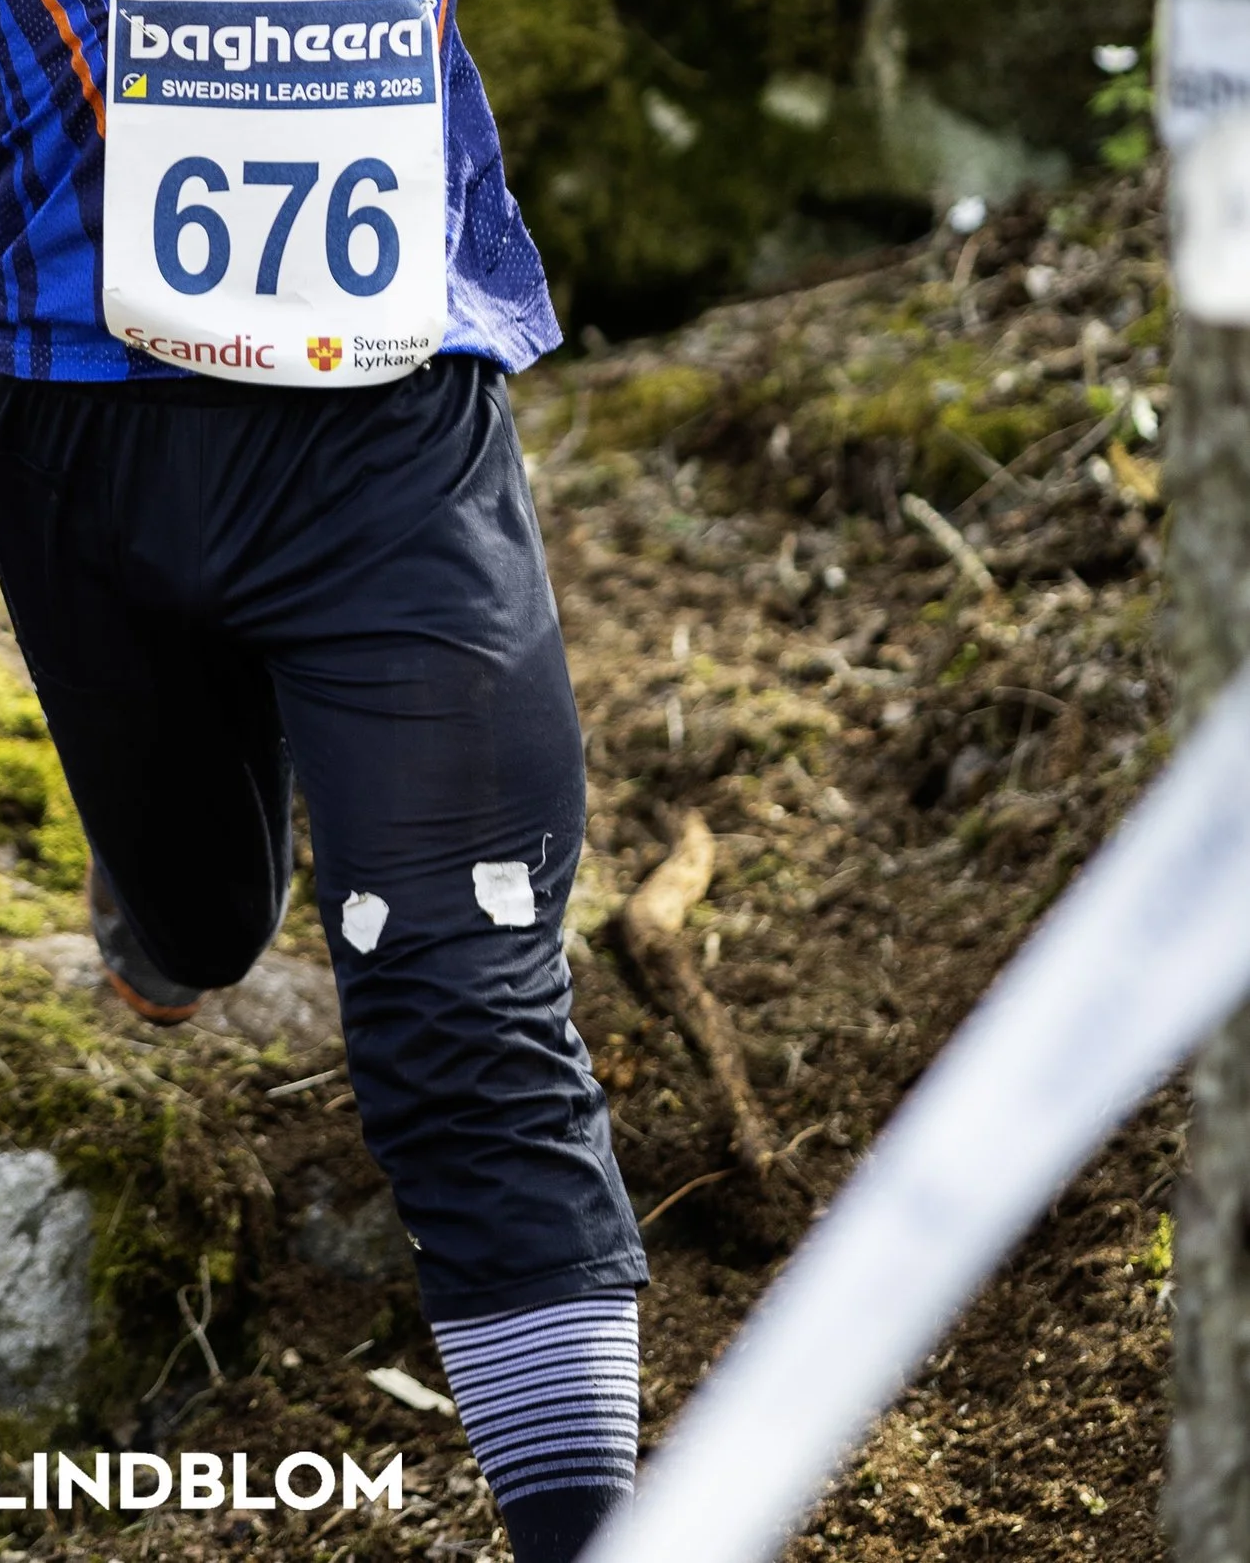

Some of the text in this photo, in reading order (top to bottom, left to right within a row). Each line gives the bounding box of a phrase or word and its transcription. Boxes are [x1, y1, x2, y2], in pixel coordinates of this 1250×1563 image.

[130, 16, 423, 71] bagheera
[161, 78, 423, 102] SWEDISH LEAGUE #3 2025
[153, 155, 400, 297] 676
[125, 327, 275, 370] Scandic
[353, 336, 429, 352] Svenska
